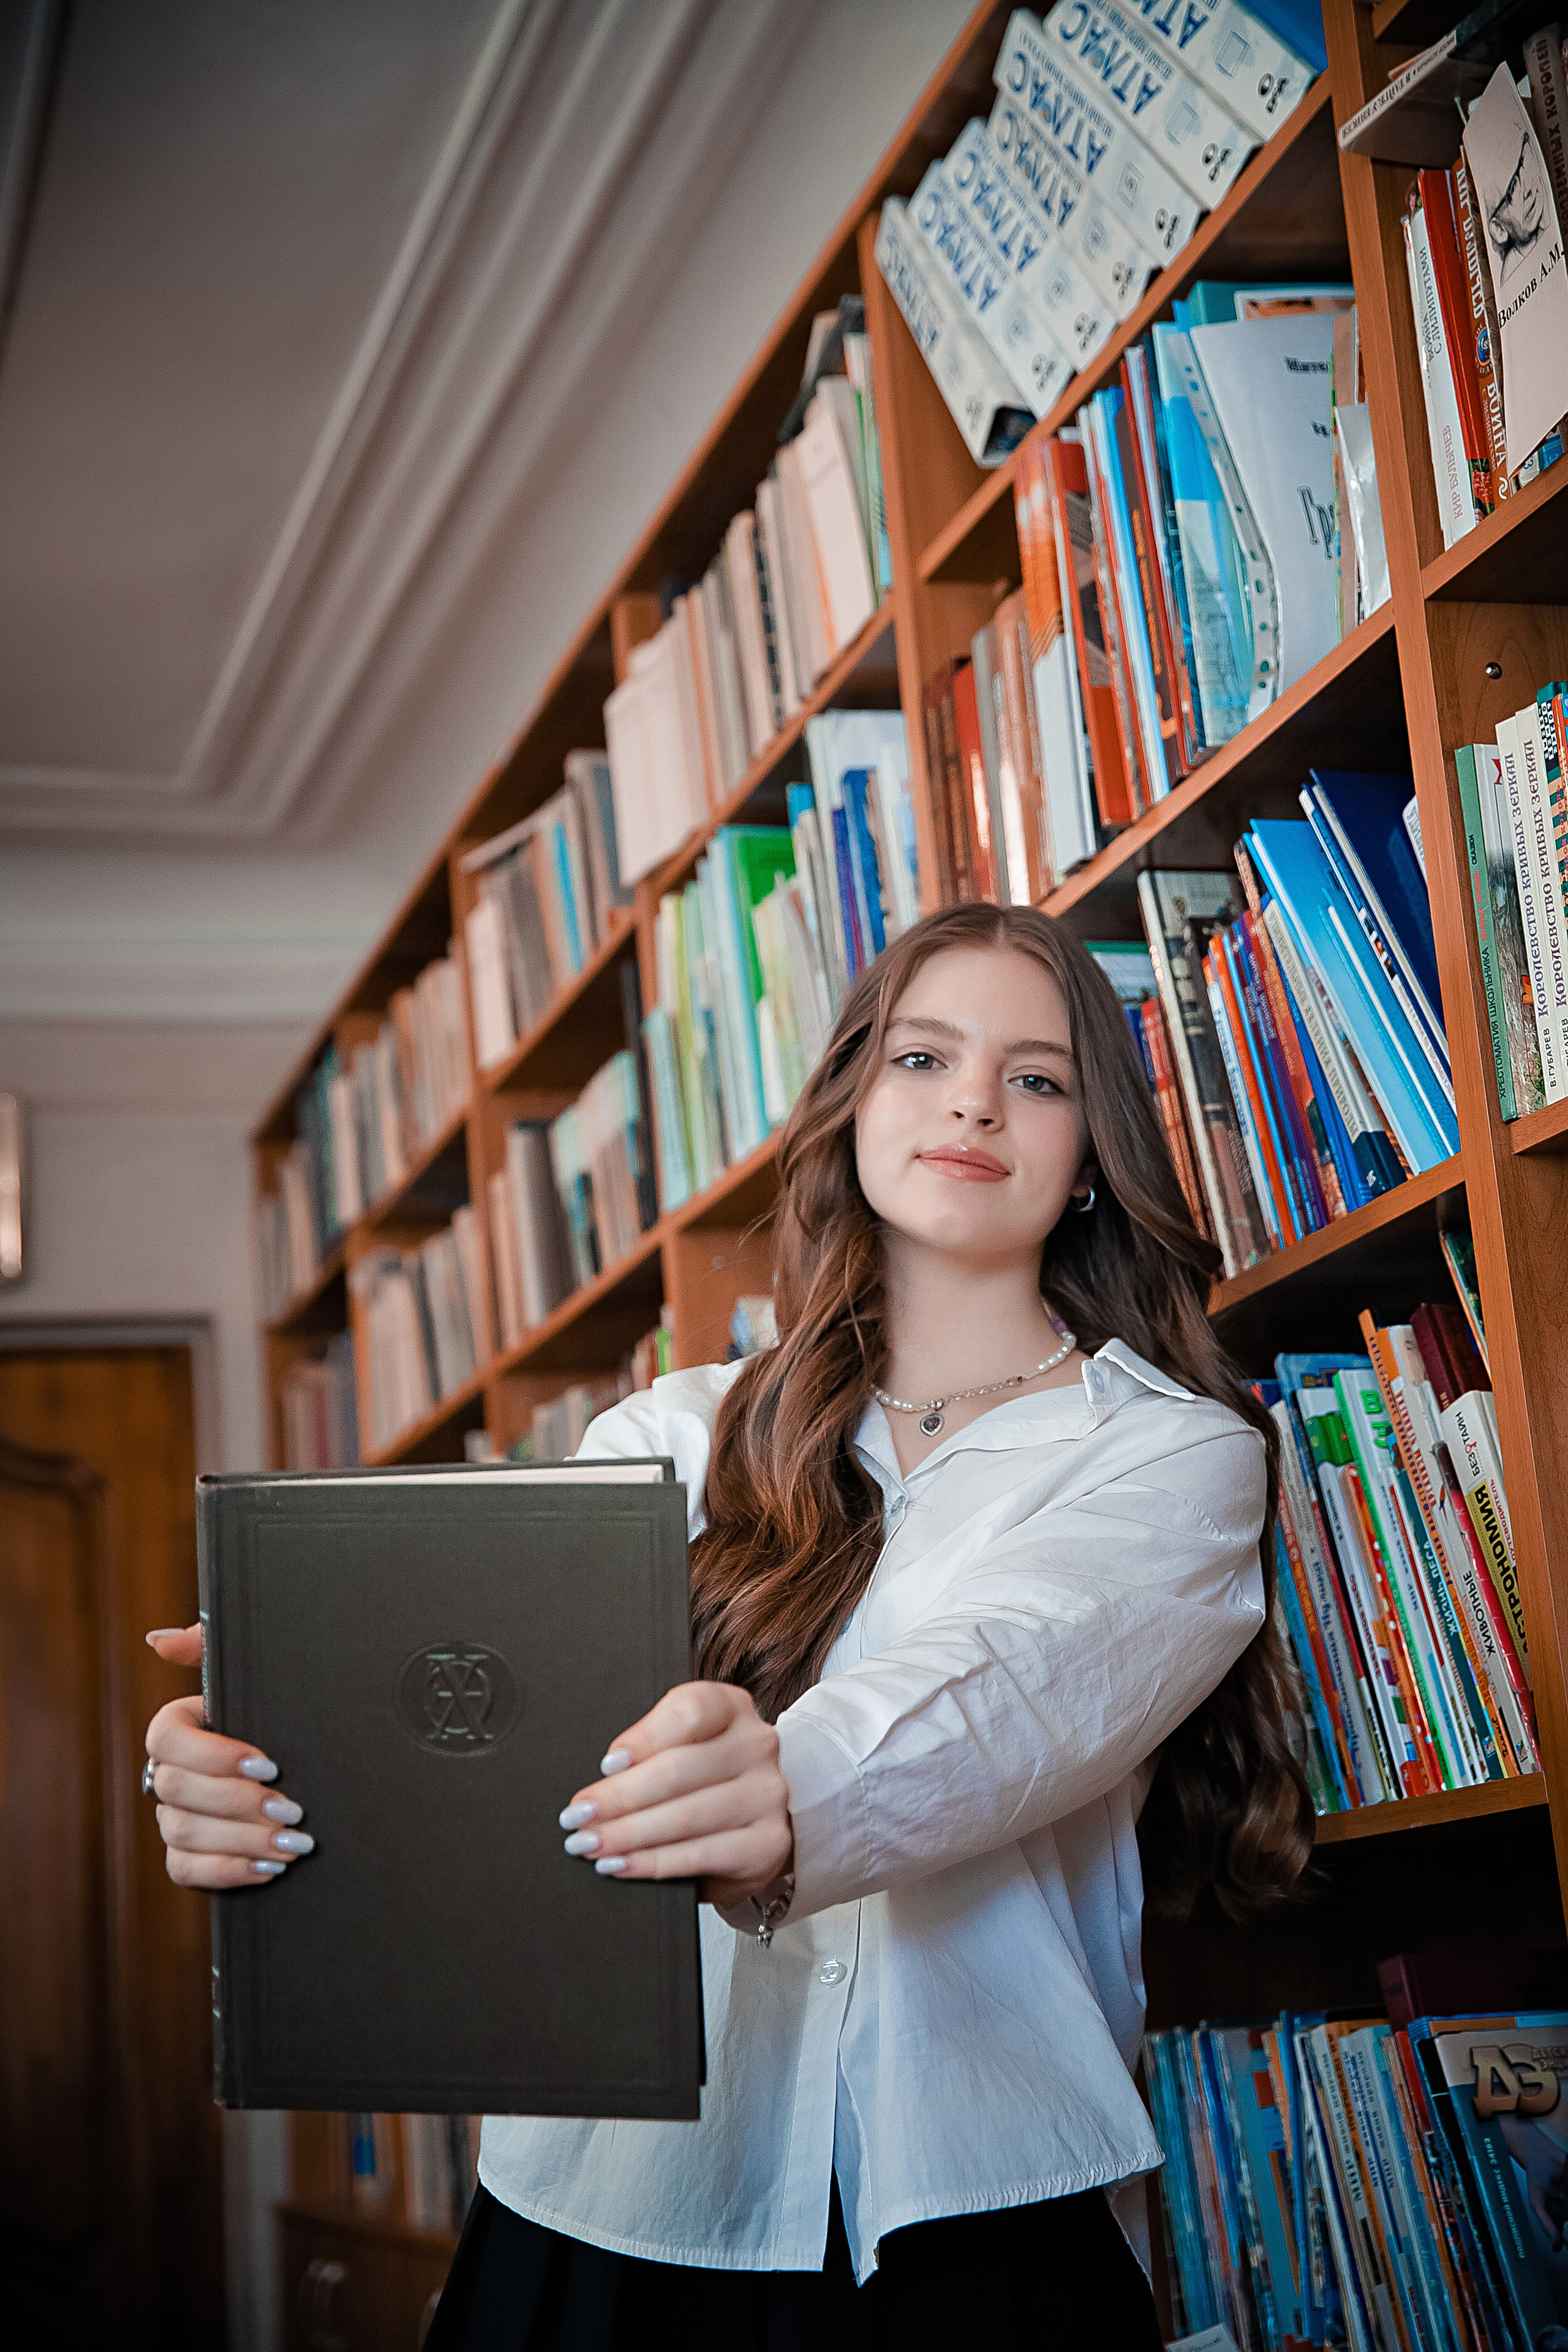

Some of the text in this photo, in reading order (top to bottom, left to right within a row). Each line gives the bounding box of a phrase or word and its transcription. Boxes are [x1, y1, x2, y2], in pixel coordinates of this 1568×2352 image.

[1058, 2, 1164, 116] АТЛАС
[1532, 39, 1558, 119] КОРОЛЕЙ
[1007, 50, 1107, 176] АТЛАС
[954, 151, 1041, 273] АТЛАС
[996, 110, 1076, 229] АТЛАС
[919, 191, 1000, 311] АТЛАС
[1419, 247, 1441, 341] ЛИЛИПУТАМИ
[1498, 241, 1565, 330] Волков А.М.
[1442, 424, 1463, 519] КИР БУЛЫЧЕВ
[1523, 740, 1541, 805] ЗЕРКАЛ
[1468, 833, 1477, 865] СКАЗКИ
[1532, 807, 1550, 880] КРИВЫХ
[1504, 752, 1556, 1088] В.ГУБАРЕВ КОРОЛЕВСТВО КРИВЫХ ЗЕРКАЛ
[1544, 883, 1568, 1008] КОРОЛЕВСТВО
[1480, 946, 1498, 1019] ШКОЛЬНИКА
[1490, 1019, 1506, 1099] ХРЕСТОМАТИЯ
[1454, 1411, 1480, 1477] БЕЗ ТАЙН
[1422, 1539, 1440, 1579] ЛЕСА
[1436, 1581, 1459, 1636] ЖИЗНЬ
[1463, 1570, 1496, 1658] ЖИВОТНЫЕ
